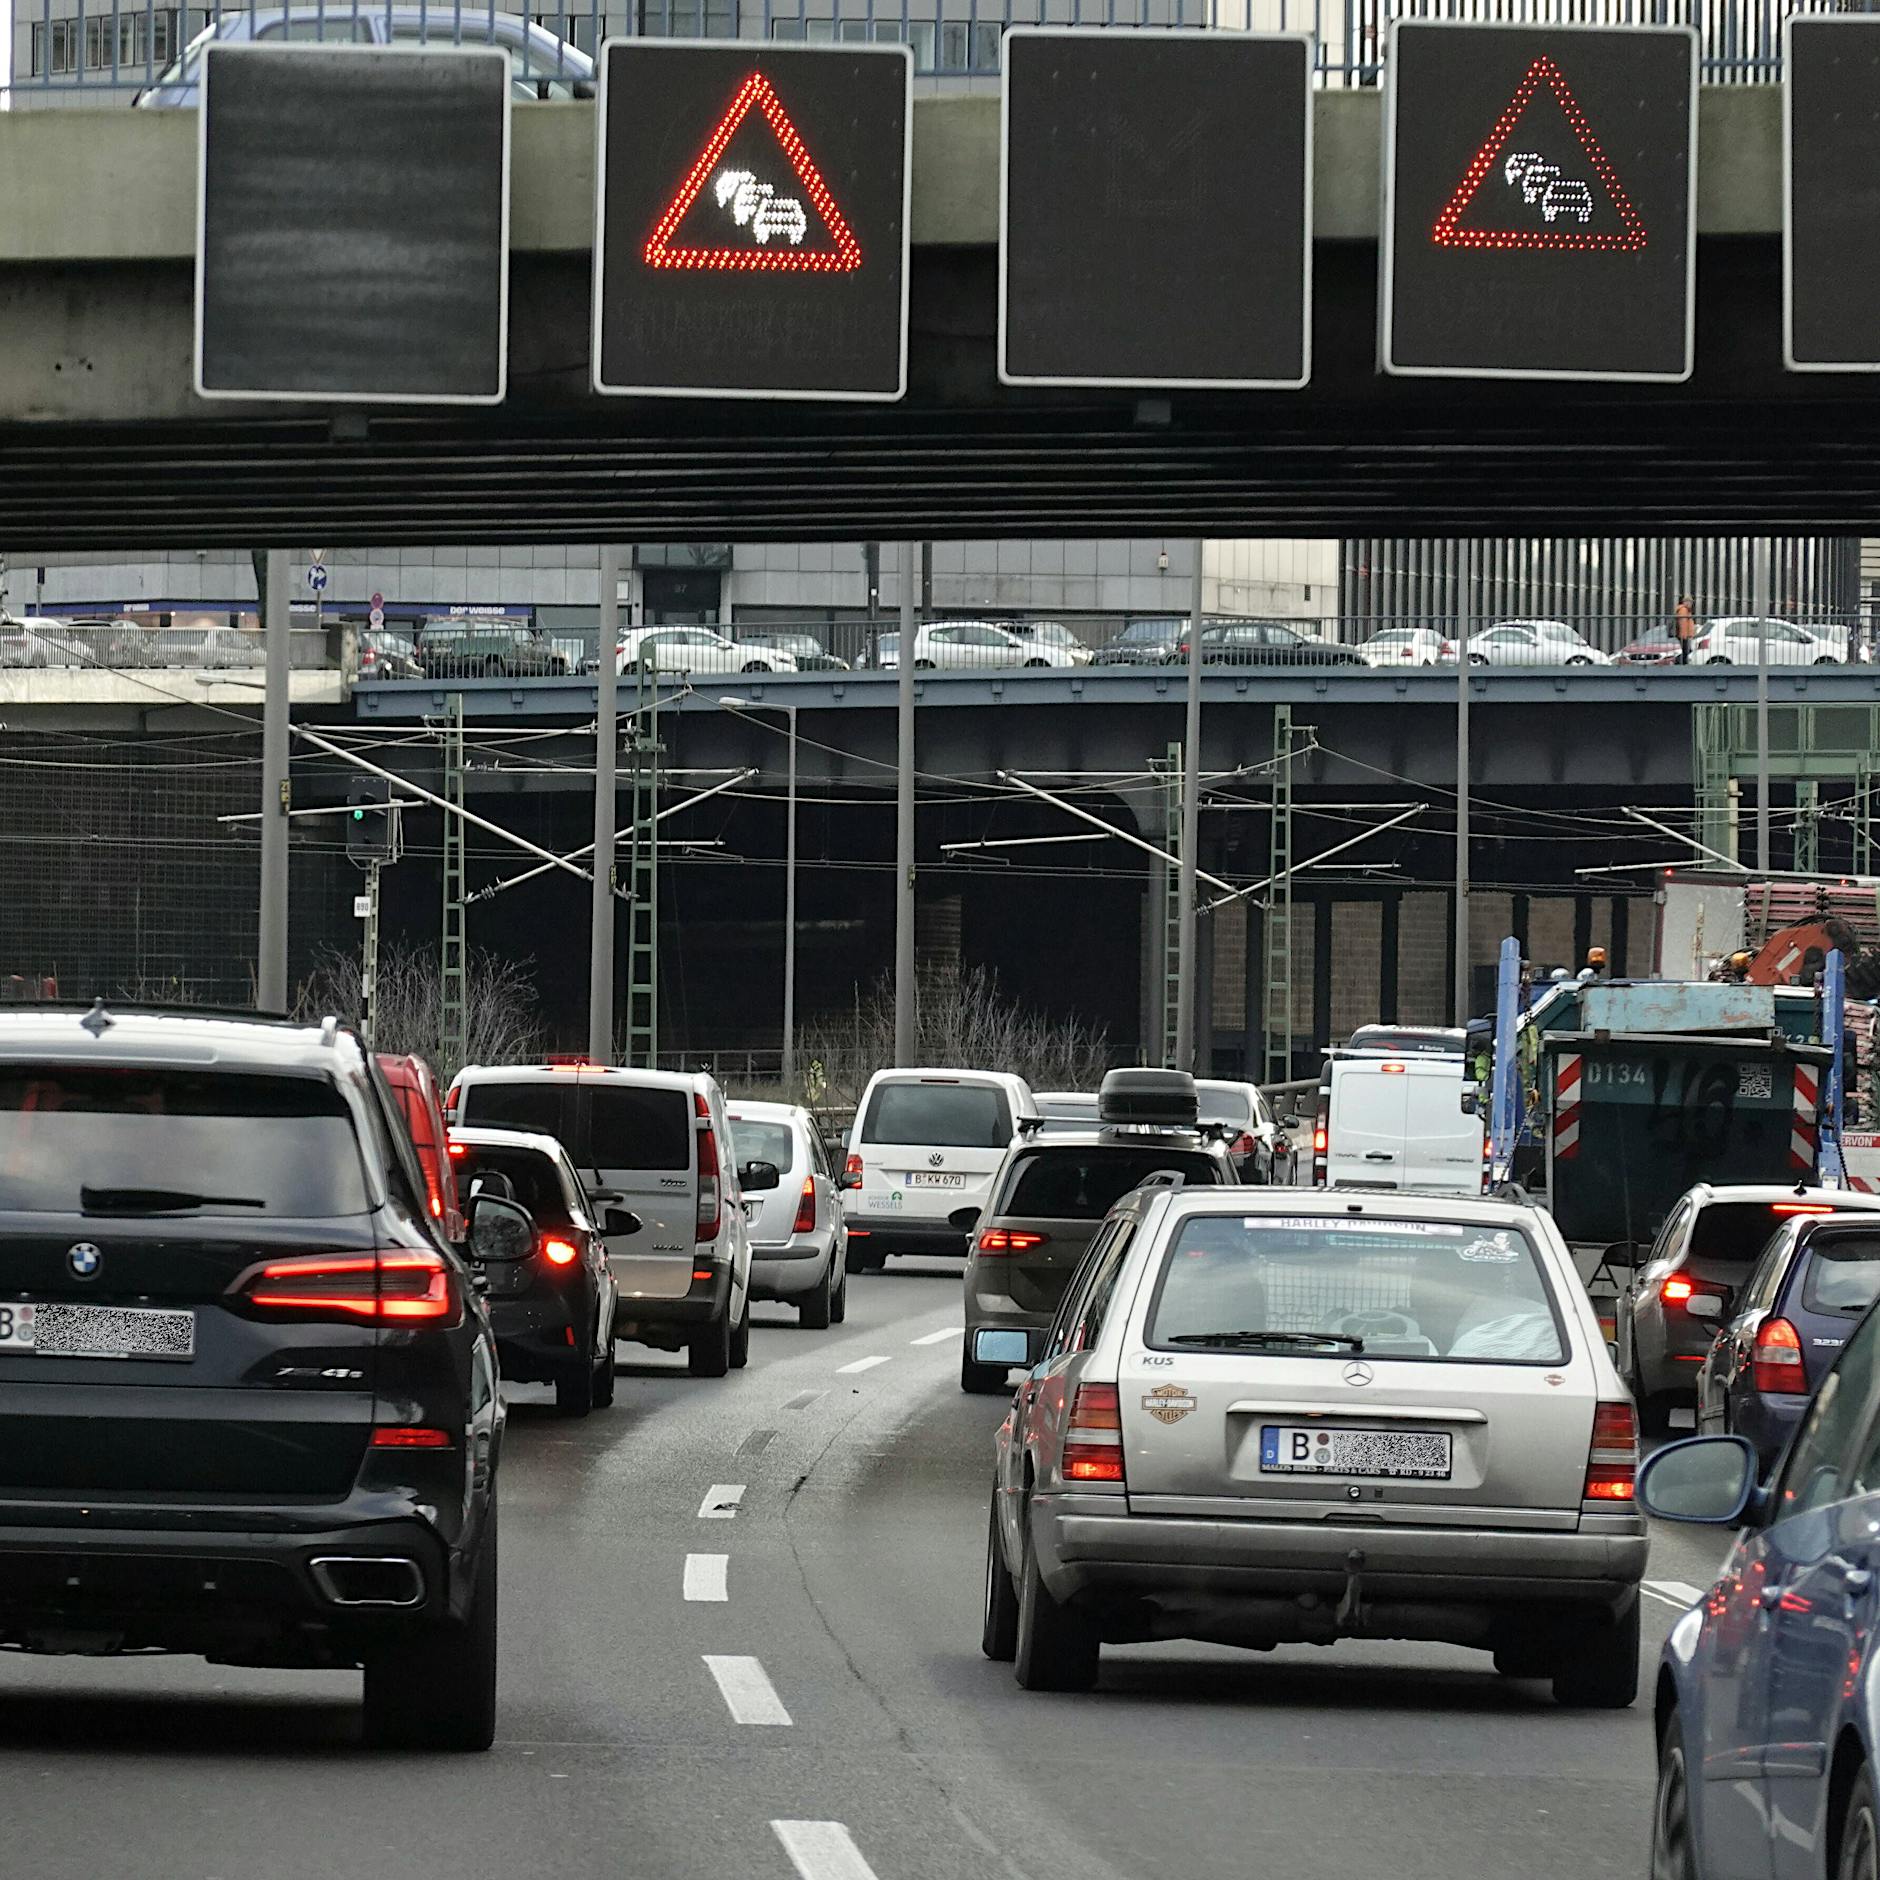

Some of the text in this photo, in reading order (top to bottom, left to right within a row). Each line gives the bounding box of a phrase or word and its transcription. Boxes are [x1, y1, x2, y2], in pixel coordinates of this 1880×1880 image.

[1587, 1061, 1646, 1086] D134
[1142, 1356, 1175, 1366] KUS
[1292, 1432, 1310, 1461] B
